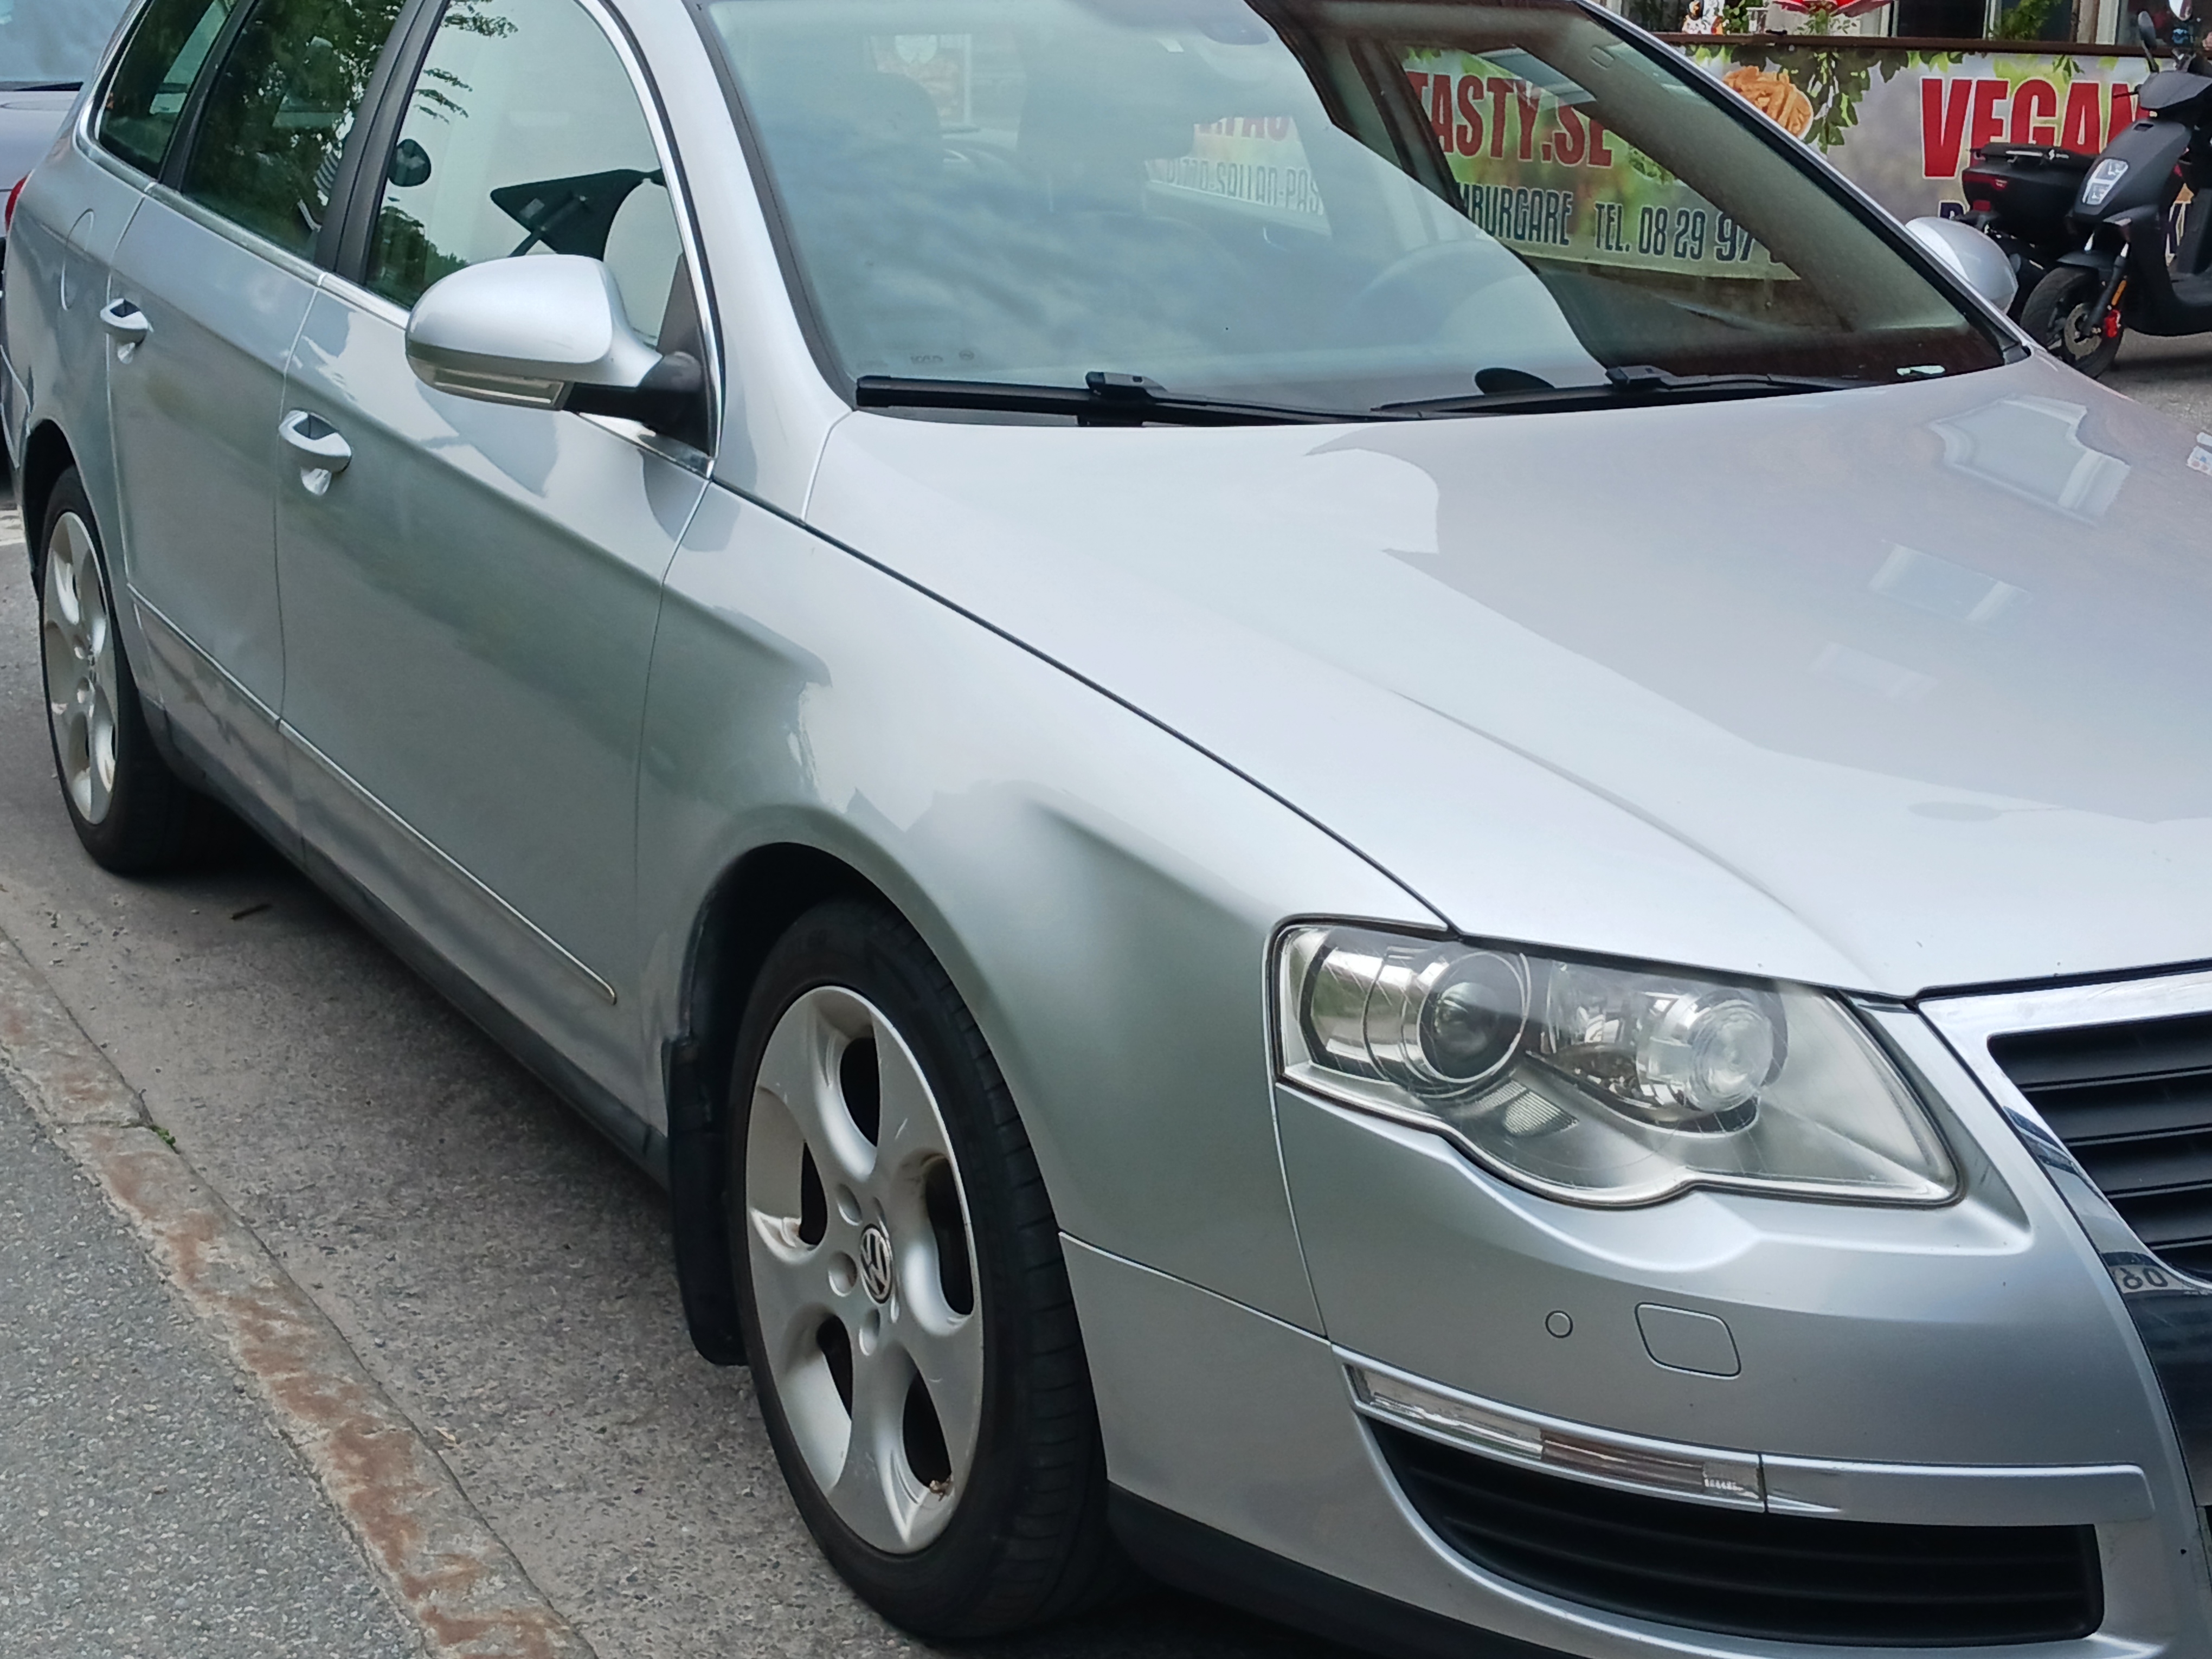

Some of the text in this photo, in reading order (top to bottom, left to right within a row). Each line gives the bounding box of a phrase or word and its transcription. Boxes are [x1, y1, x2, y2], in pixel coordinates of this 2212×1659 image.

[1463, 183, 1572, 245] BURGARE
[1596, 202, 1630, 252] TEL.
[1639, 205, 1668, 255] 08
[1674, 209, 1706, 260] 29
